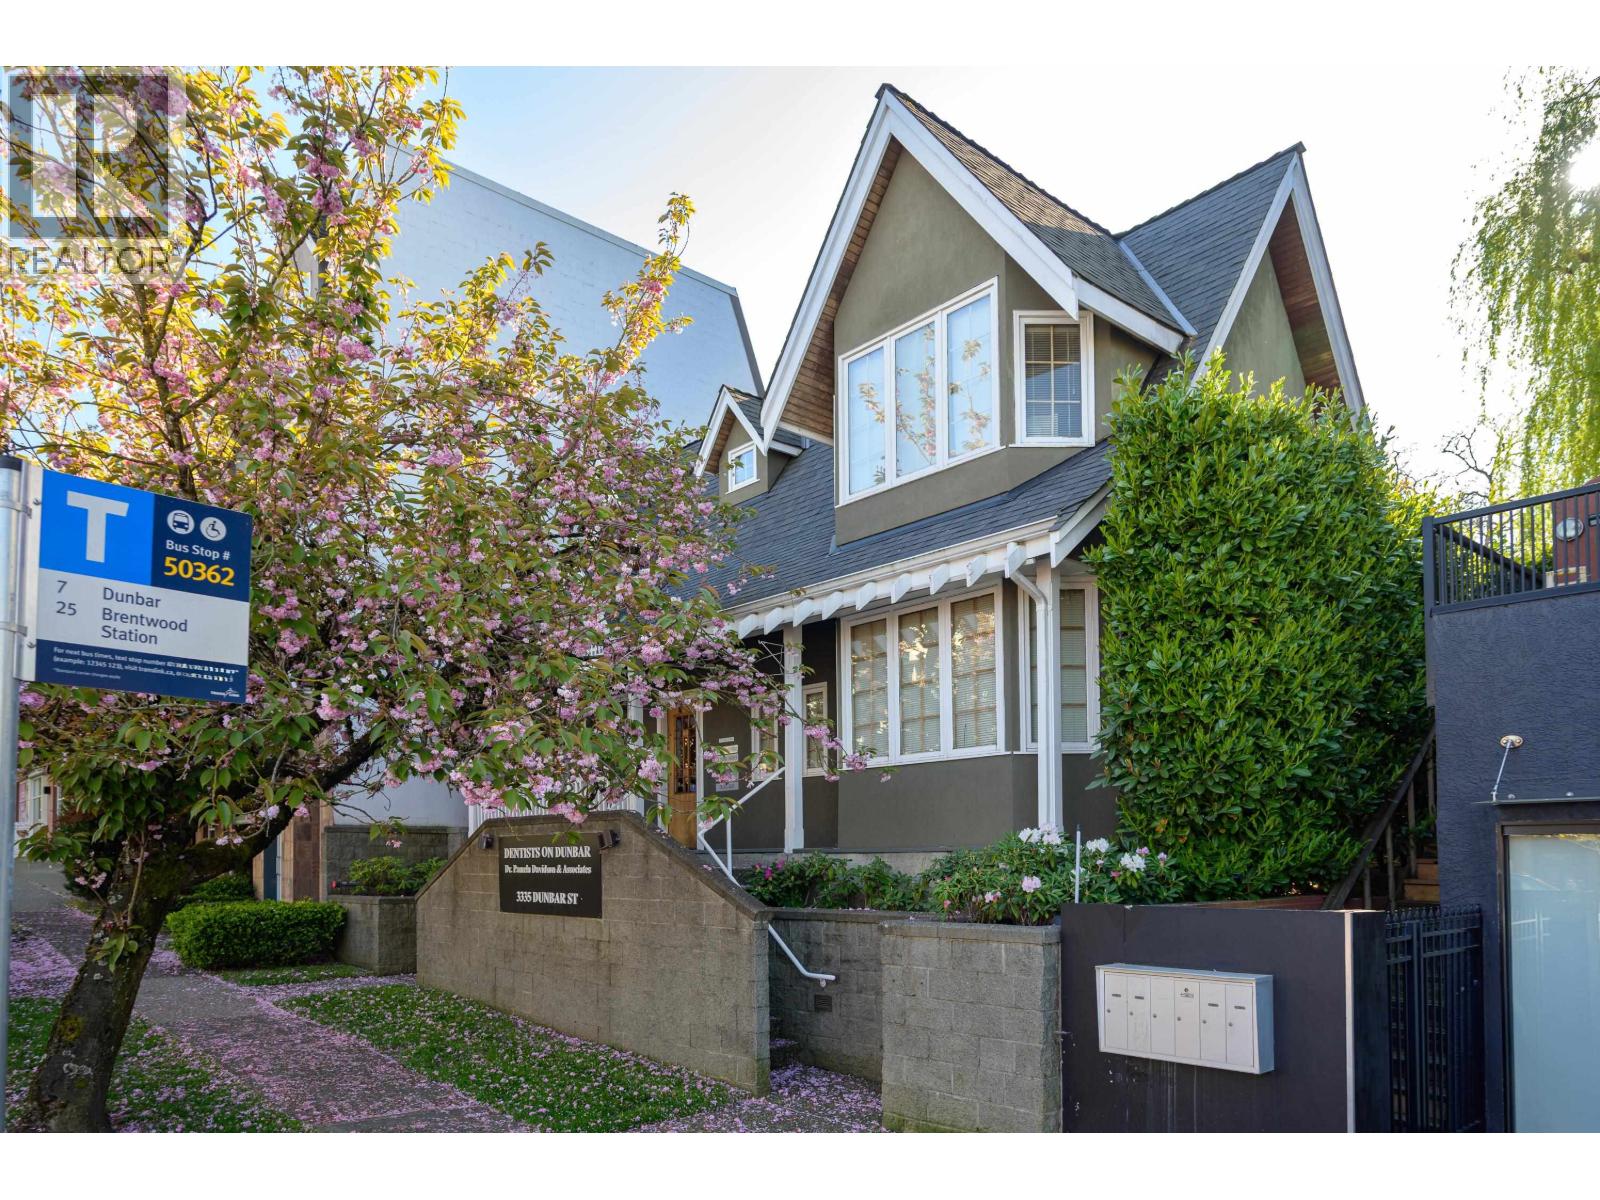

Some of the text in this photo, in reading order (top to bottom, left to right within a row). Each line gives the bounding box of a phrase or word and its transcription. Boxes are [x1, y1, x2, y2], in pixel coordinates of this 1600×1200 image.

[67, 491, 129, 563] T
[166, 540, 189, 553] Bus
[192, 545, 220, 560] Stop
[164, 556, 235, 586] 50362
[57, 580, 161, 608] 7 Dunbar
[56, 601, 188, 632] 25 Brentwood
[101, 625, 158, 644] Station
[504, 845, 592, 859] DENTISTS ON DUNBAR
[504, 864, 513, 874] Dr.
[556, 864, 562, 874] &
[563, 864, 592, 875] Associates
[516, 891, 579, 905] 3335 DUNBAR ST
